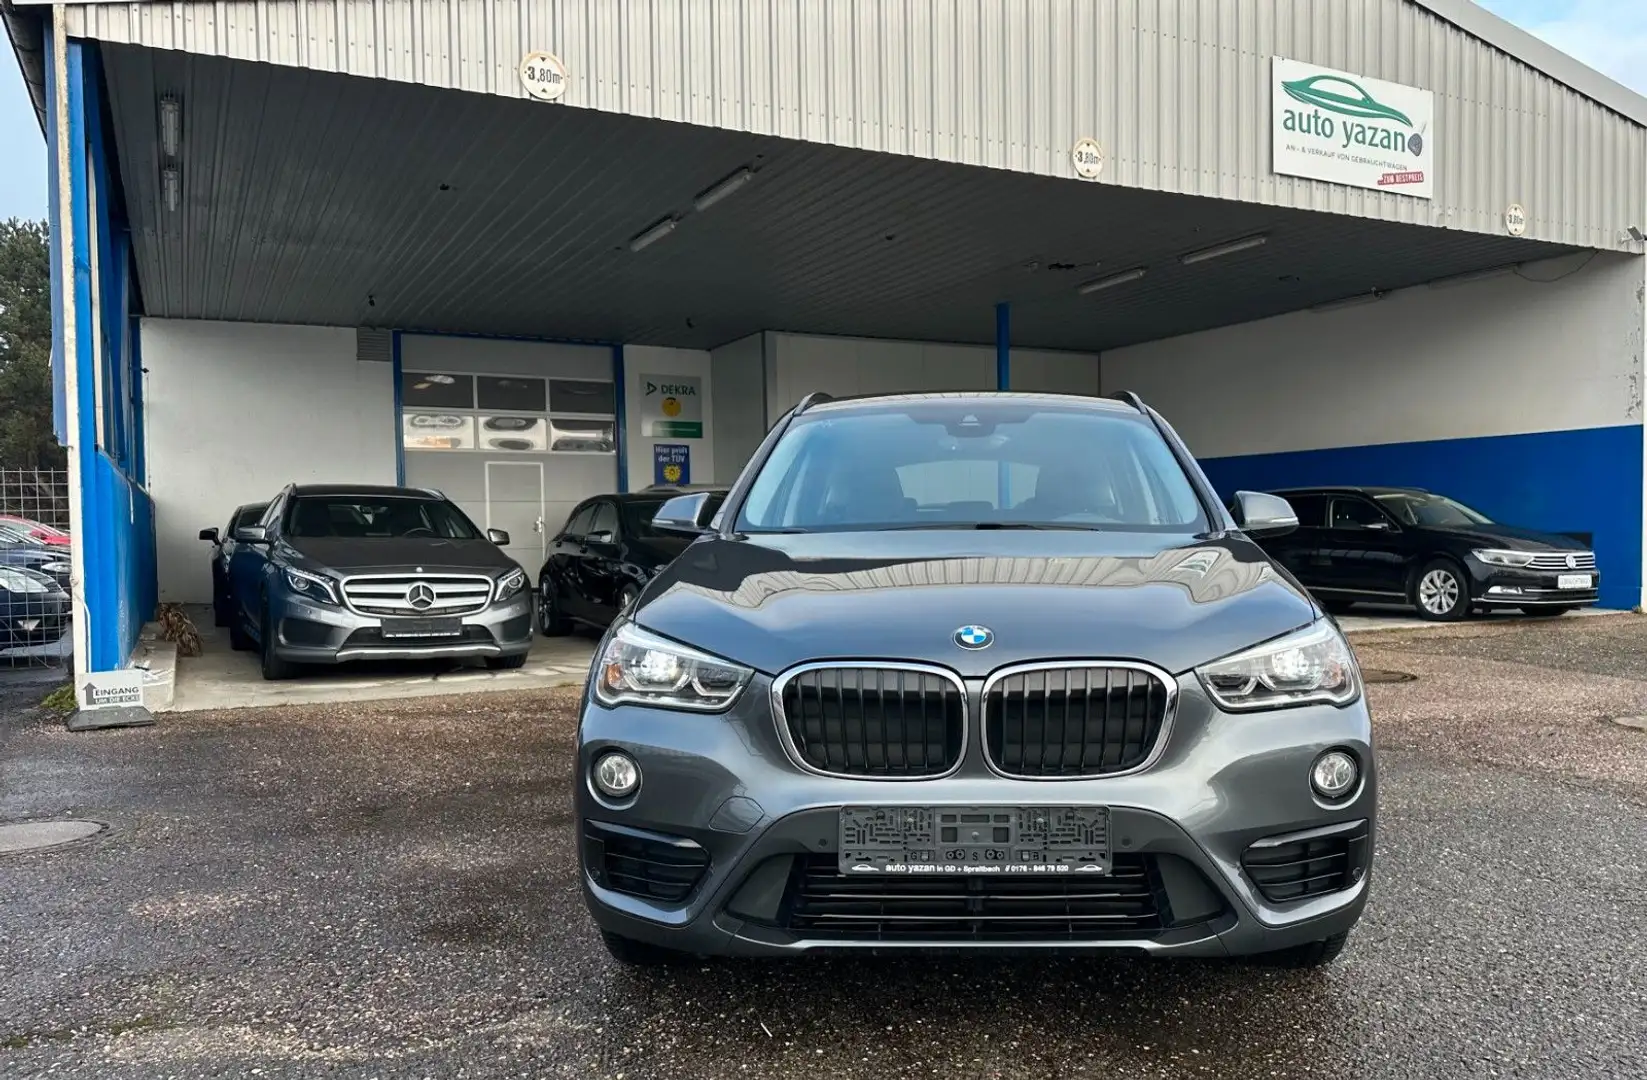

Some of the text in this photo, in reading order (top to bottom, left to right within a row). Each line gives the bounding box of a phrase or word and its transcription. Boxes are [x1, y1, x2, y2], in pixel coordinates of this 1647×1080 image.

[528, 66, 560, 84] 3,80m
[1283, 109, 1406, 152] auto yazan
[1307, 148, 1335, 158] VERKAUF
[1337, 153, 1350, 161] VON
[1351, 155, 1408, 171] GEBRAUCHTWAGEN
[661, 384, 697, 396] DEKRA
[658, 454, 670, 462] der
[95, 686, 140, 696] EINGANG
[109, 696, 120, 704] DIE
[122, 694, 139, 702] ECKE
[885, 863, 907, 872] auto
[908, 864, 936, 874] yazan
[937, 864, 944, 872] in
